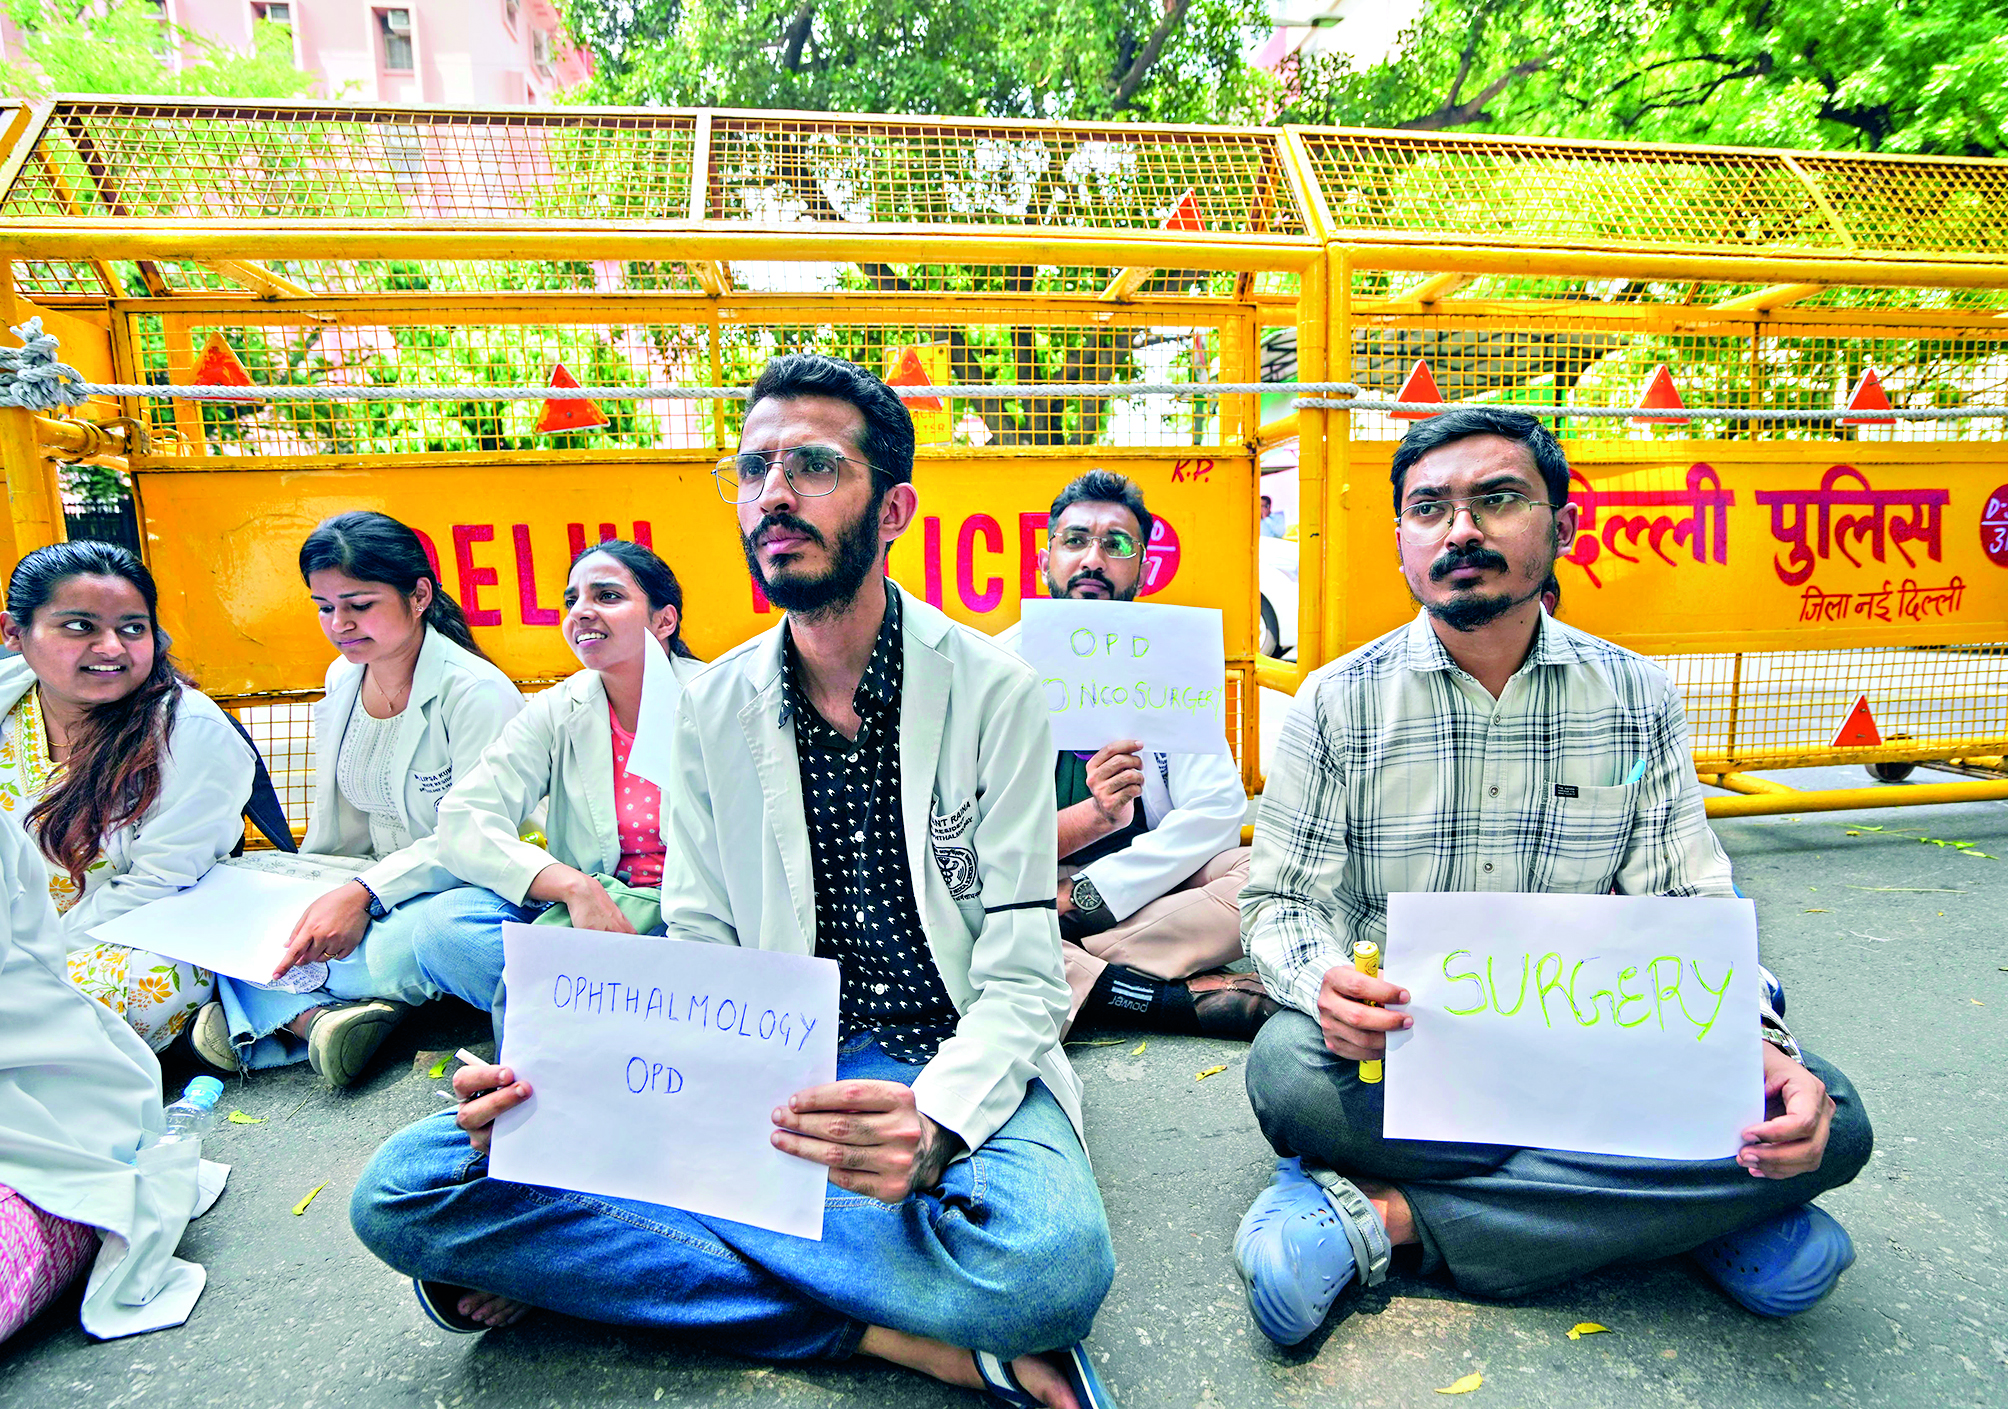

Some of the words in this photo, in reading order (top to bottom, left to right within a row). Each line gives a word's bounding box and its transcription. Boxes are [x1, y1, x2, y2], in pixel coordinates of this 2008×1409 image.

[1755, 465, 1950, 587] पुलिस
[1799, 585, 1853, 622] जिला
[1855, 580, 1893, 622] नई
[1897, 576, 1966, 621] दिल्ली
[1070, 627, 1149, 658] OPD
[553, 974, 818, 1052] OPHTHALMOLOGY
[1443, 949, 1733, 1042] SURGERY
[626, 1057, 683, 1094] OPD
